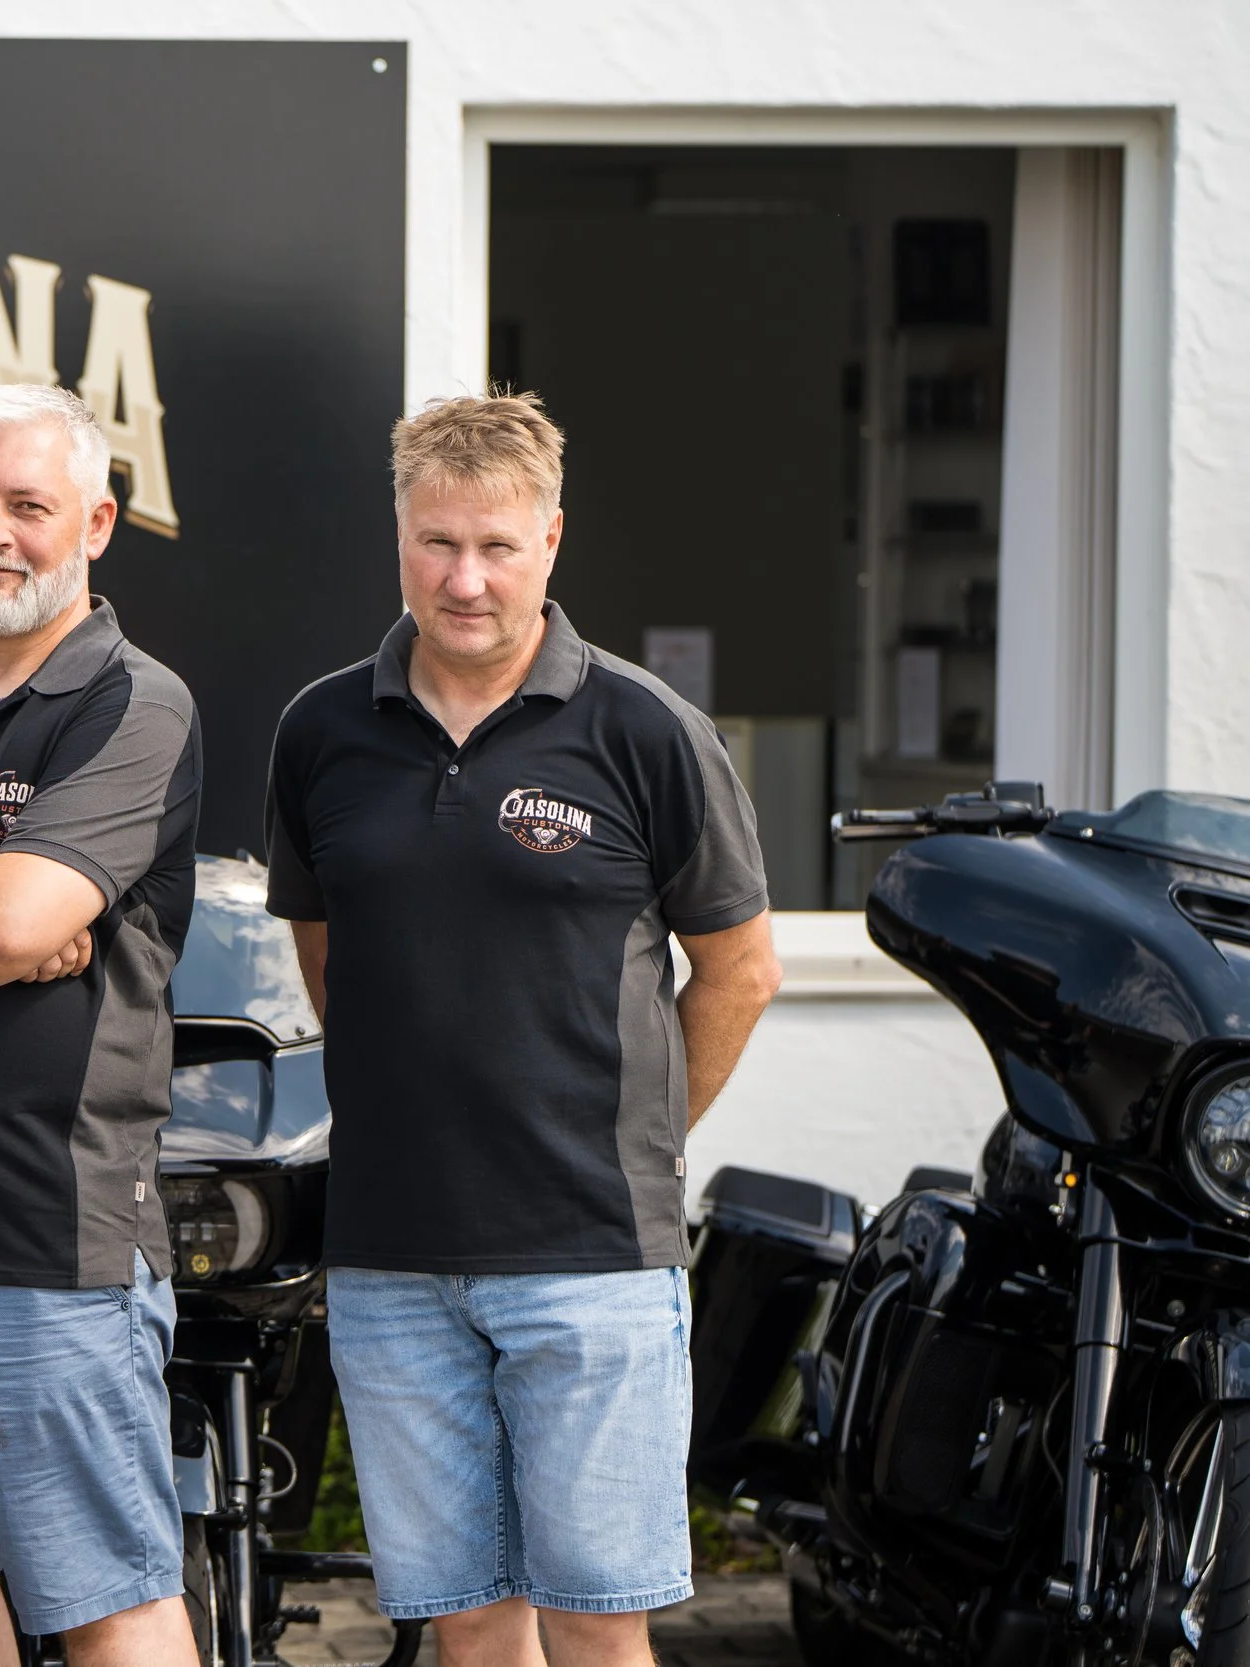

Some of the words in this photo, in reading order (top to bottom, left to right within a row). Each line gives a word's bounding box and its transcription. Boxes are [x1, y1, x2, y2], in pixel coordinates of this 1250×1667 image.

[500, 789, 592, 837] GASOLINA
[523, 819, 570, 832] CUSTOM
[517, 832, 572, 850] MOTORCYCLES
